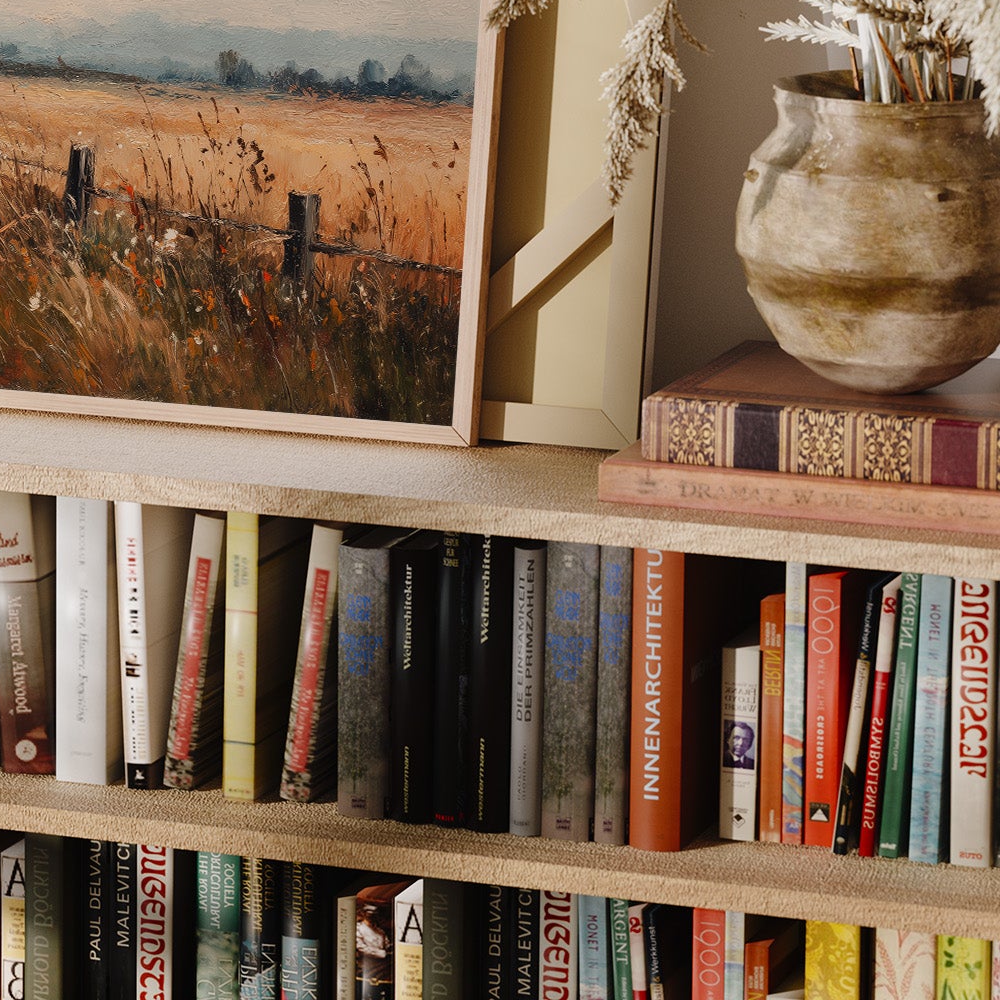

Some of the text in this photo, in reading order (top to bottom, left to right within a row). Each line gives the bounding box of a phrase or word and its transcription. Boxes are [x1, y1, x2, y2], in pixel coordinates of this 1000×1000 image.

[403, 564, 413, 671] Weltarchitektur
[480, 534, 491, 645] Weltarchitek
[6, 595, 32, 715] Margaret Atwood
[515, 574, 528, 722] DIE EINSAMKEIT
[524, 559, 536, 722] DER PRIMZAHLEN
[643, 549, 664, 801] INNENARCHITEKTU
[477, 738, 485, 821] westermann
[89, 840, 102, 962] PAUL DELVAU
[400, 904, 423, 944] A
[489, 885, 502, 957] DELVAU
[587, 914, 599, 952] MONET
[612, 897, 629, 966] ARGENT
[629, 916, 642, 934] 2
[649, 925, 660, 974] Werkkunst
[694, 920, 721, 987] 1900
